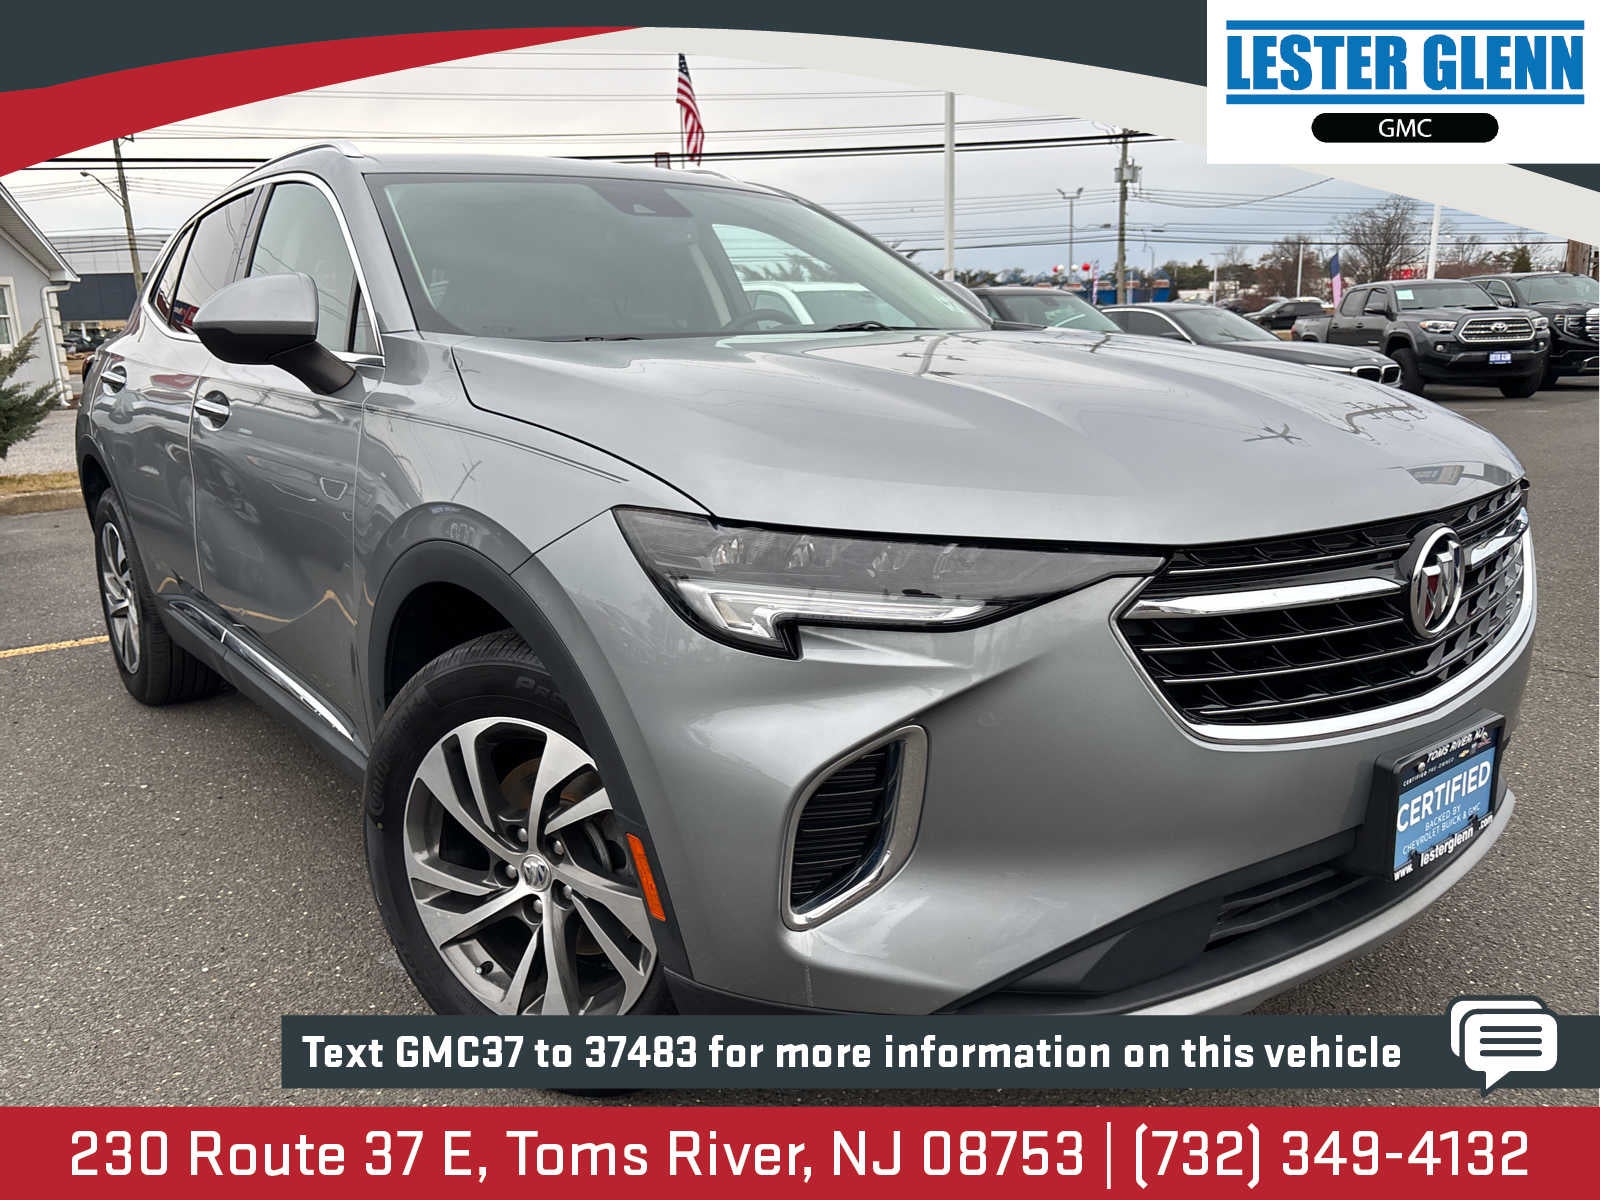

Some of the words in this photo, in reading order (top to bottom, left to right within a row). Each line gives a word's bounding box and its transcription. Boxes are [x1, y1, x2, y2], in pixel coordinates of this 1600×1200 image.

[1427, 745, 1450, 762] TOMS
[1450, 734, 1473, 752] RIVER
[1396, 760, 1491, 832] CERTIFIED
[1402, 825, 1440, 856] CHEVROLET
[1441, 816, 1461, 831] BUICK
[1468, 802, 1480, 816] GMC
[1425, 810, 1450, 831] BACKED
[1452, 804, 1461, 815] BY
[1419, 826, 1474, 868] lesterglenn
